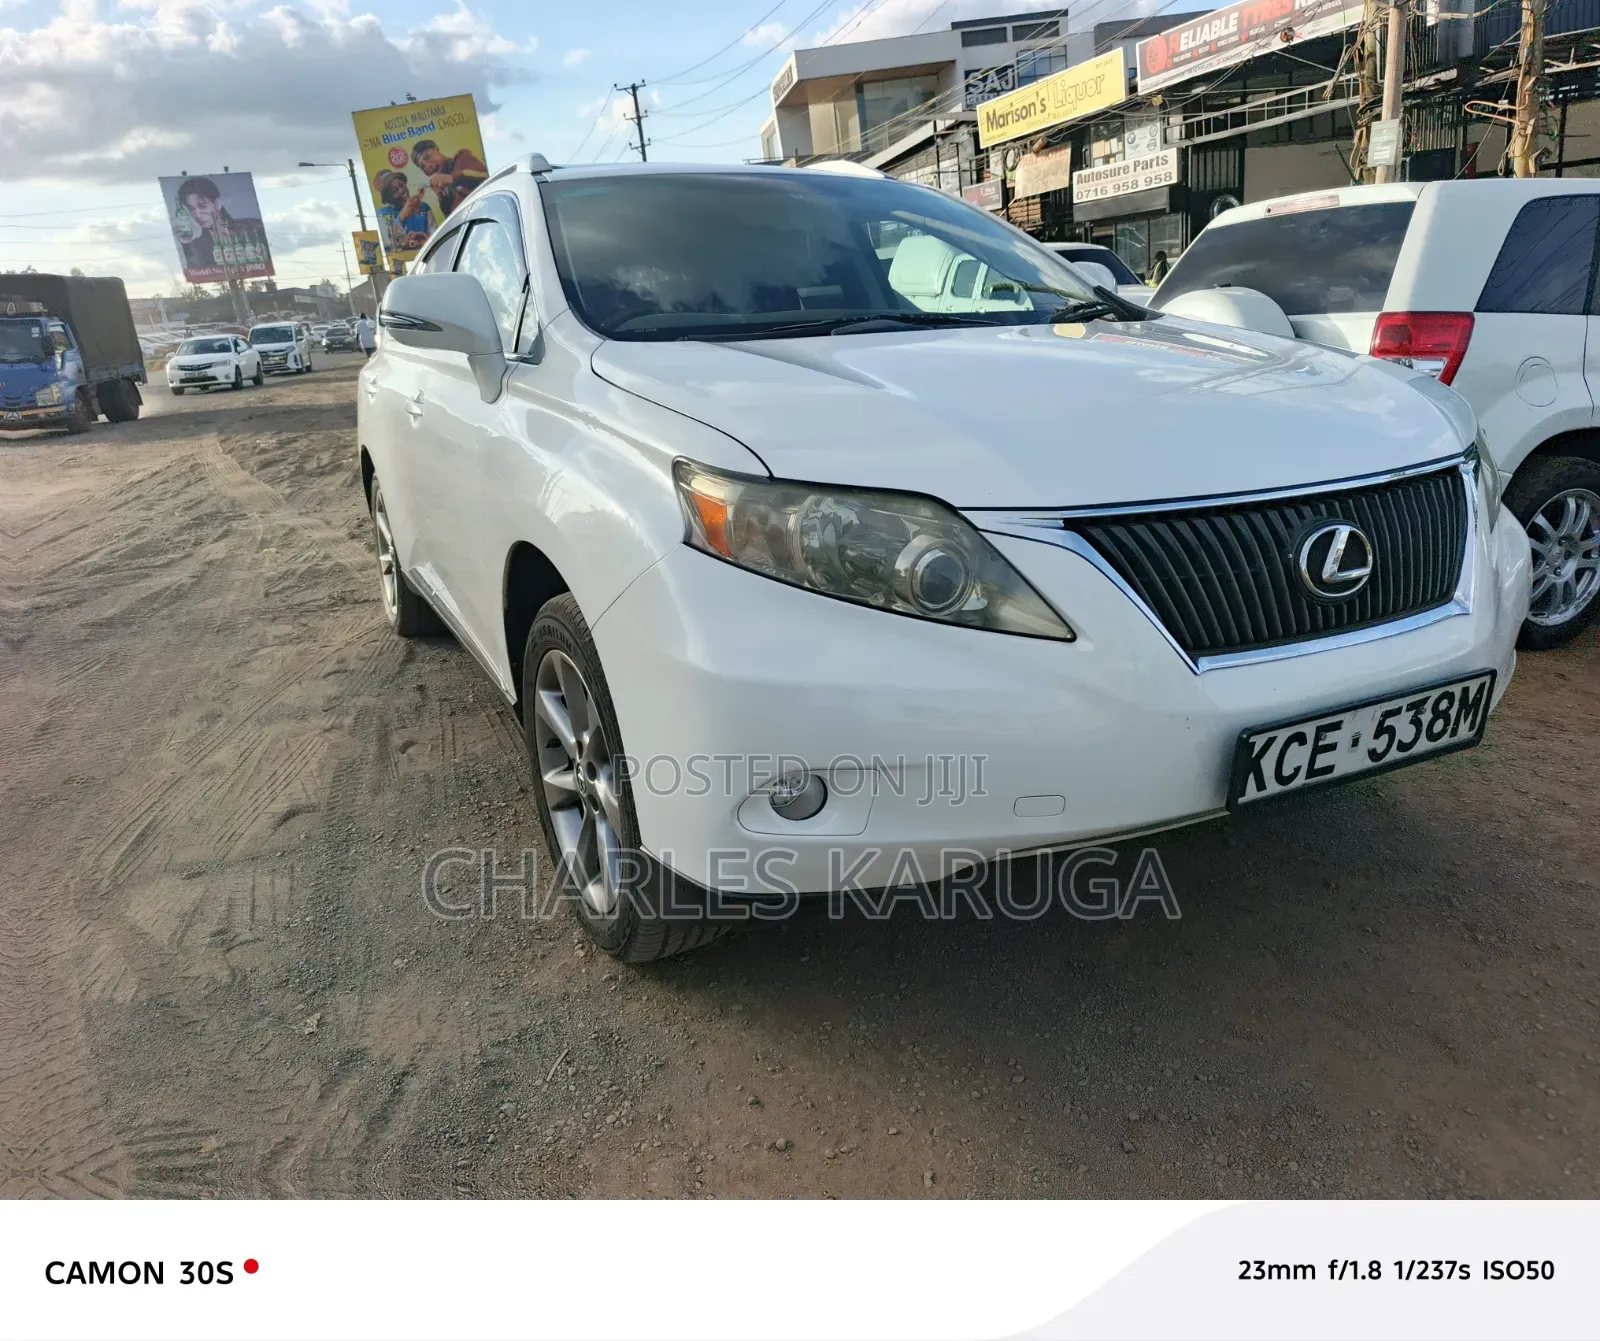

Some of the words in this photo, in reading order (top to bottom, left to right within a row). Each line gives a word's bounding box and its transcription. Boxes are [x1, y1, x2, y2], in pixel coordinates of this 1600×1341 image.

[1168, 12, 1239, 55] RELIABLE
[966, 67, 1014, 94] SAJ
[986, 91, 1047, 133] Marison's
[1052, 74, 1105, 110] Liquor
[382, 131, 407, 144] Blue
[407, 120, 436, 138] Band
[437, 112, 465, 130] CHOCO
[1076, 164, 1130, 185] Autosure
[1133, 154, 1169, 173] Parts
[1076, 186, 1108, 200] 0716
[1112, 179, 1139, 194] 958
[1144, 172, 1173, 187] 958
[1245, 719, 1344, 793] KCE
[1367, 681, 1487, 763] 538M
